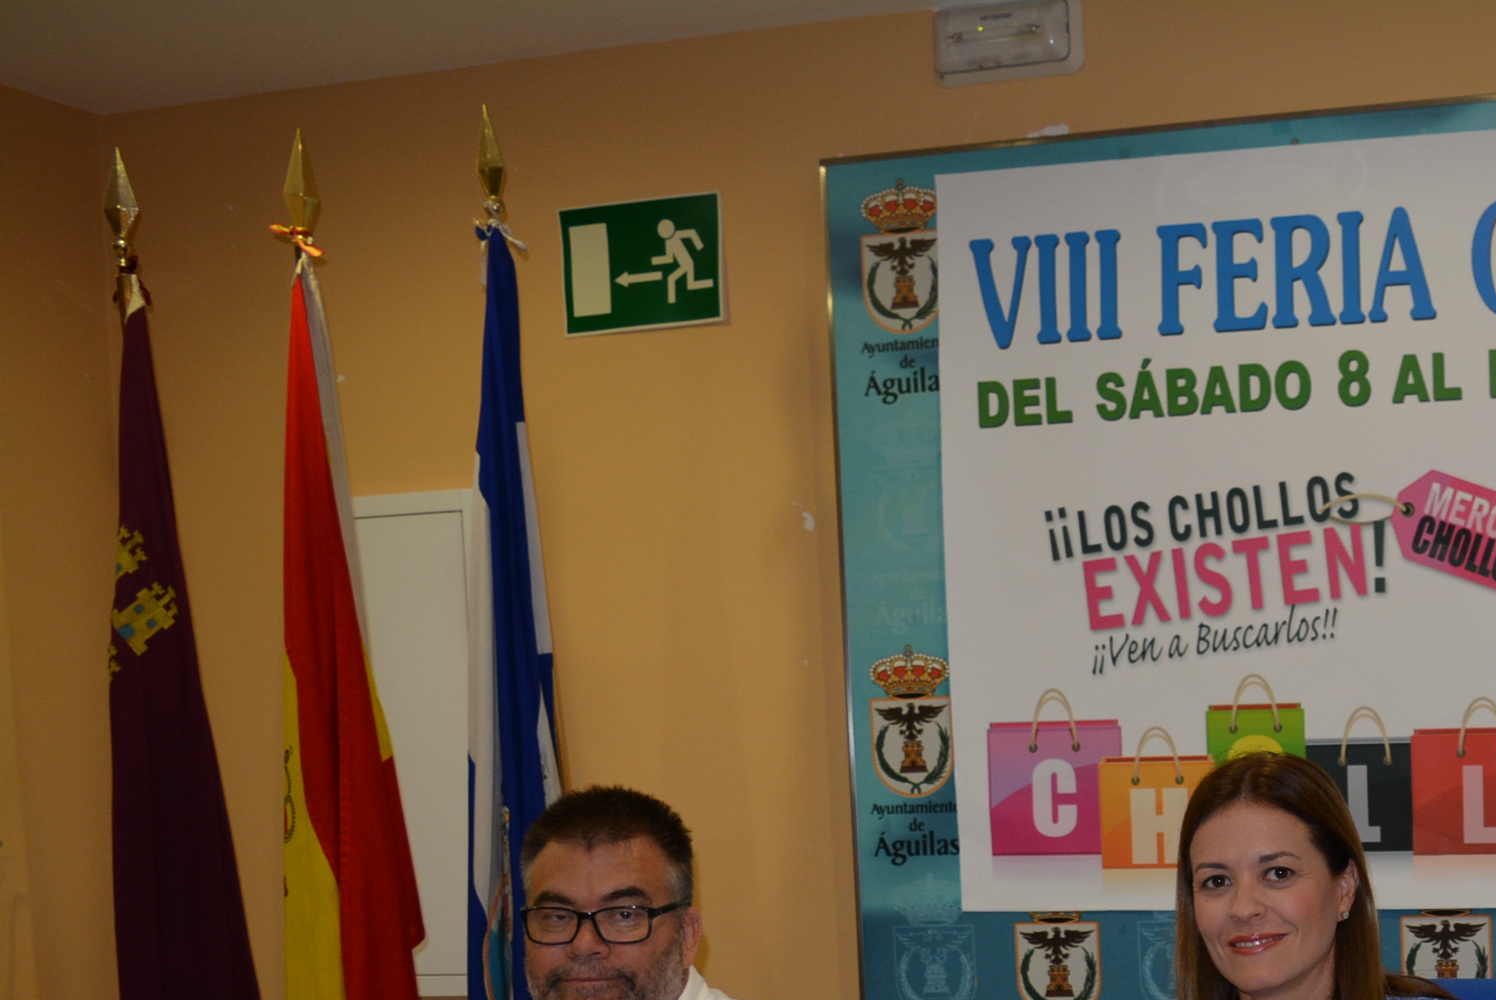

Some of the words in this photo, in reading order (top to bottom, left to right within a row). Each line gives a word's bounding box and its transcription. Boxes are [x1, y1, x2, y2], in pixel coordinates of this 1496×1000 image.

[968, 228, 1123, 350] VIII
[1155, 206, 1437, 337] FERIA
[861, 338, 938, 356] Ayuntamien
[900, 356, 916, 368] de
[865, 371, 940, 403] Águila
[977, 376, 1074, 429] DEL
[1095, 357, 1312, 422] SÁBADO
[1337, 349, 1372, 408] 8
[1391, 351, 1463, 405] AL
[1044, 501, 1155, 562] ¡¡LOS
[1168, 471, 1361, 541] CHOLLOS
[1082, 521, 1387, 631] EXISTEN!
[1168, 634, 1189, 657] a
[1196, 604, 1338, 656] Buscarlos!!
[909, 817, 925, 831] de
[874, 831, 960, 865] Águilas
